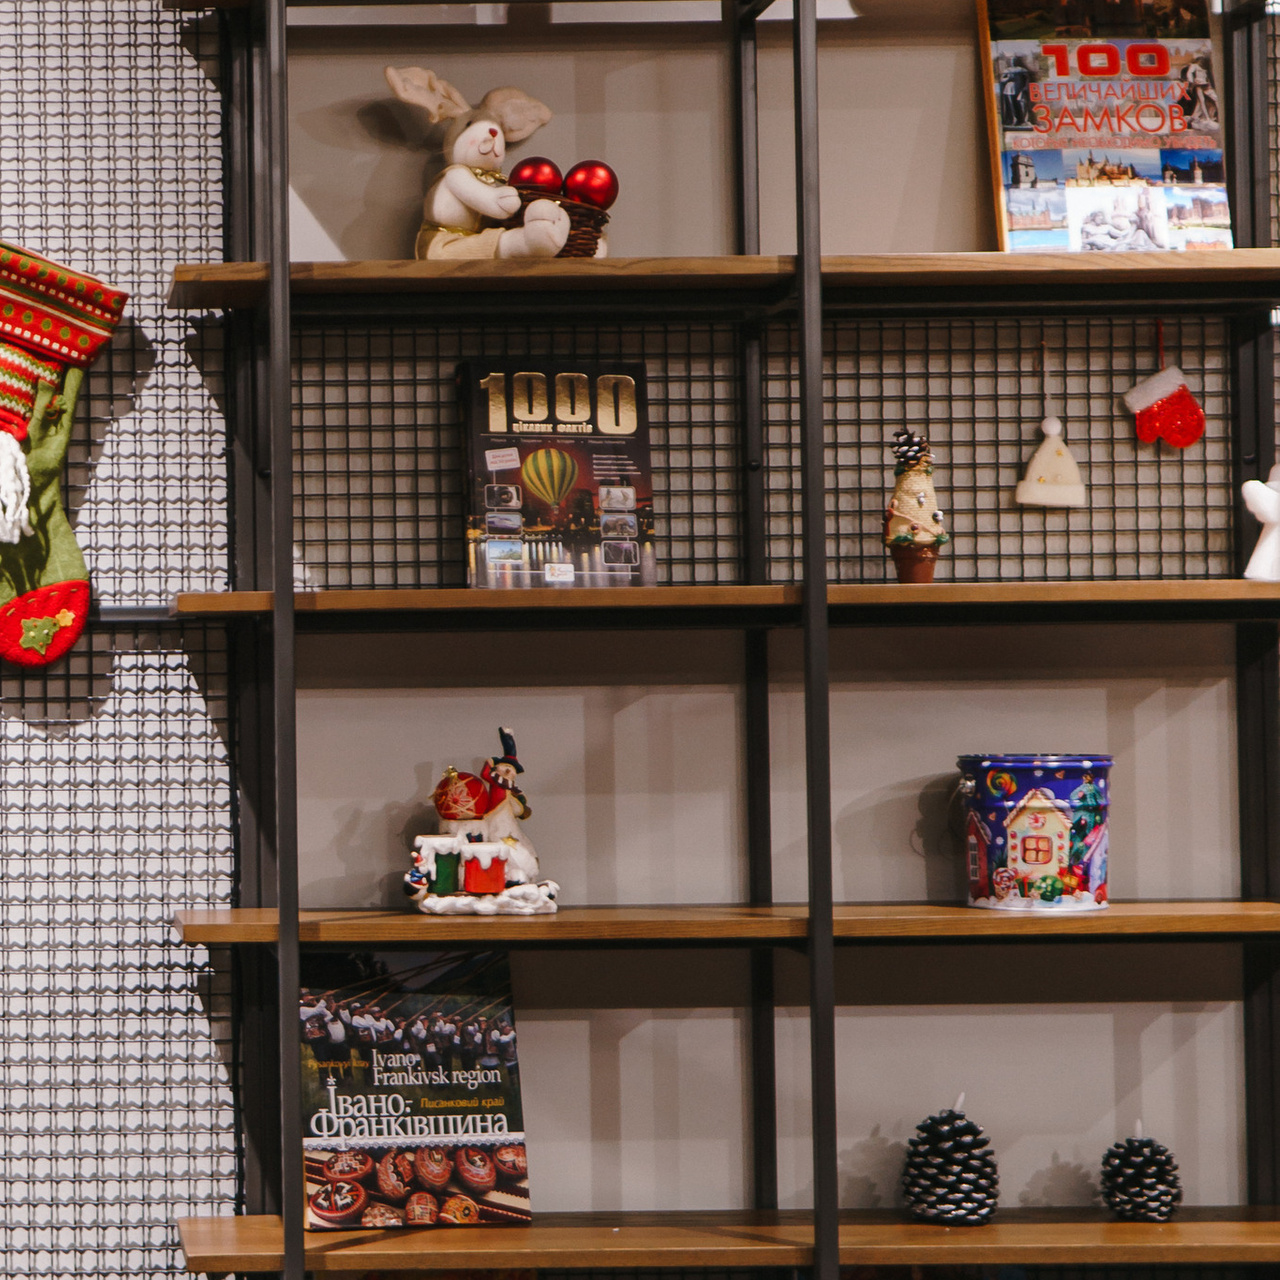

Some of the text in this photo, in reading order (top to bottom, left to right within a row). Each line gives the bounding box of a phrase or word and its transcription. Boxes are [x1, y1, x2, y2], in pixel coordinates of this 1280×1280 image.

[1041, 43, 1171, 77] 100
[1029, 79, 1191, 101] ВЕЛИЧАЙШИХ
[1032, 104, 1188, 133] ЗАМКОВ
[480, 372, 637, 435] 1000
[373, 1065, 502, 1090] Frankivsk region
[310, 1108, 509, 1151] Франківщина
